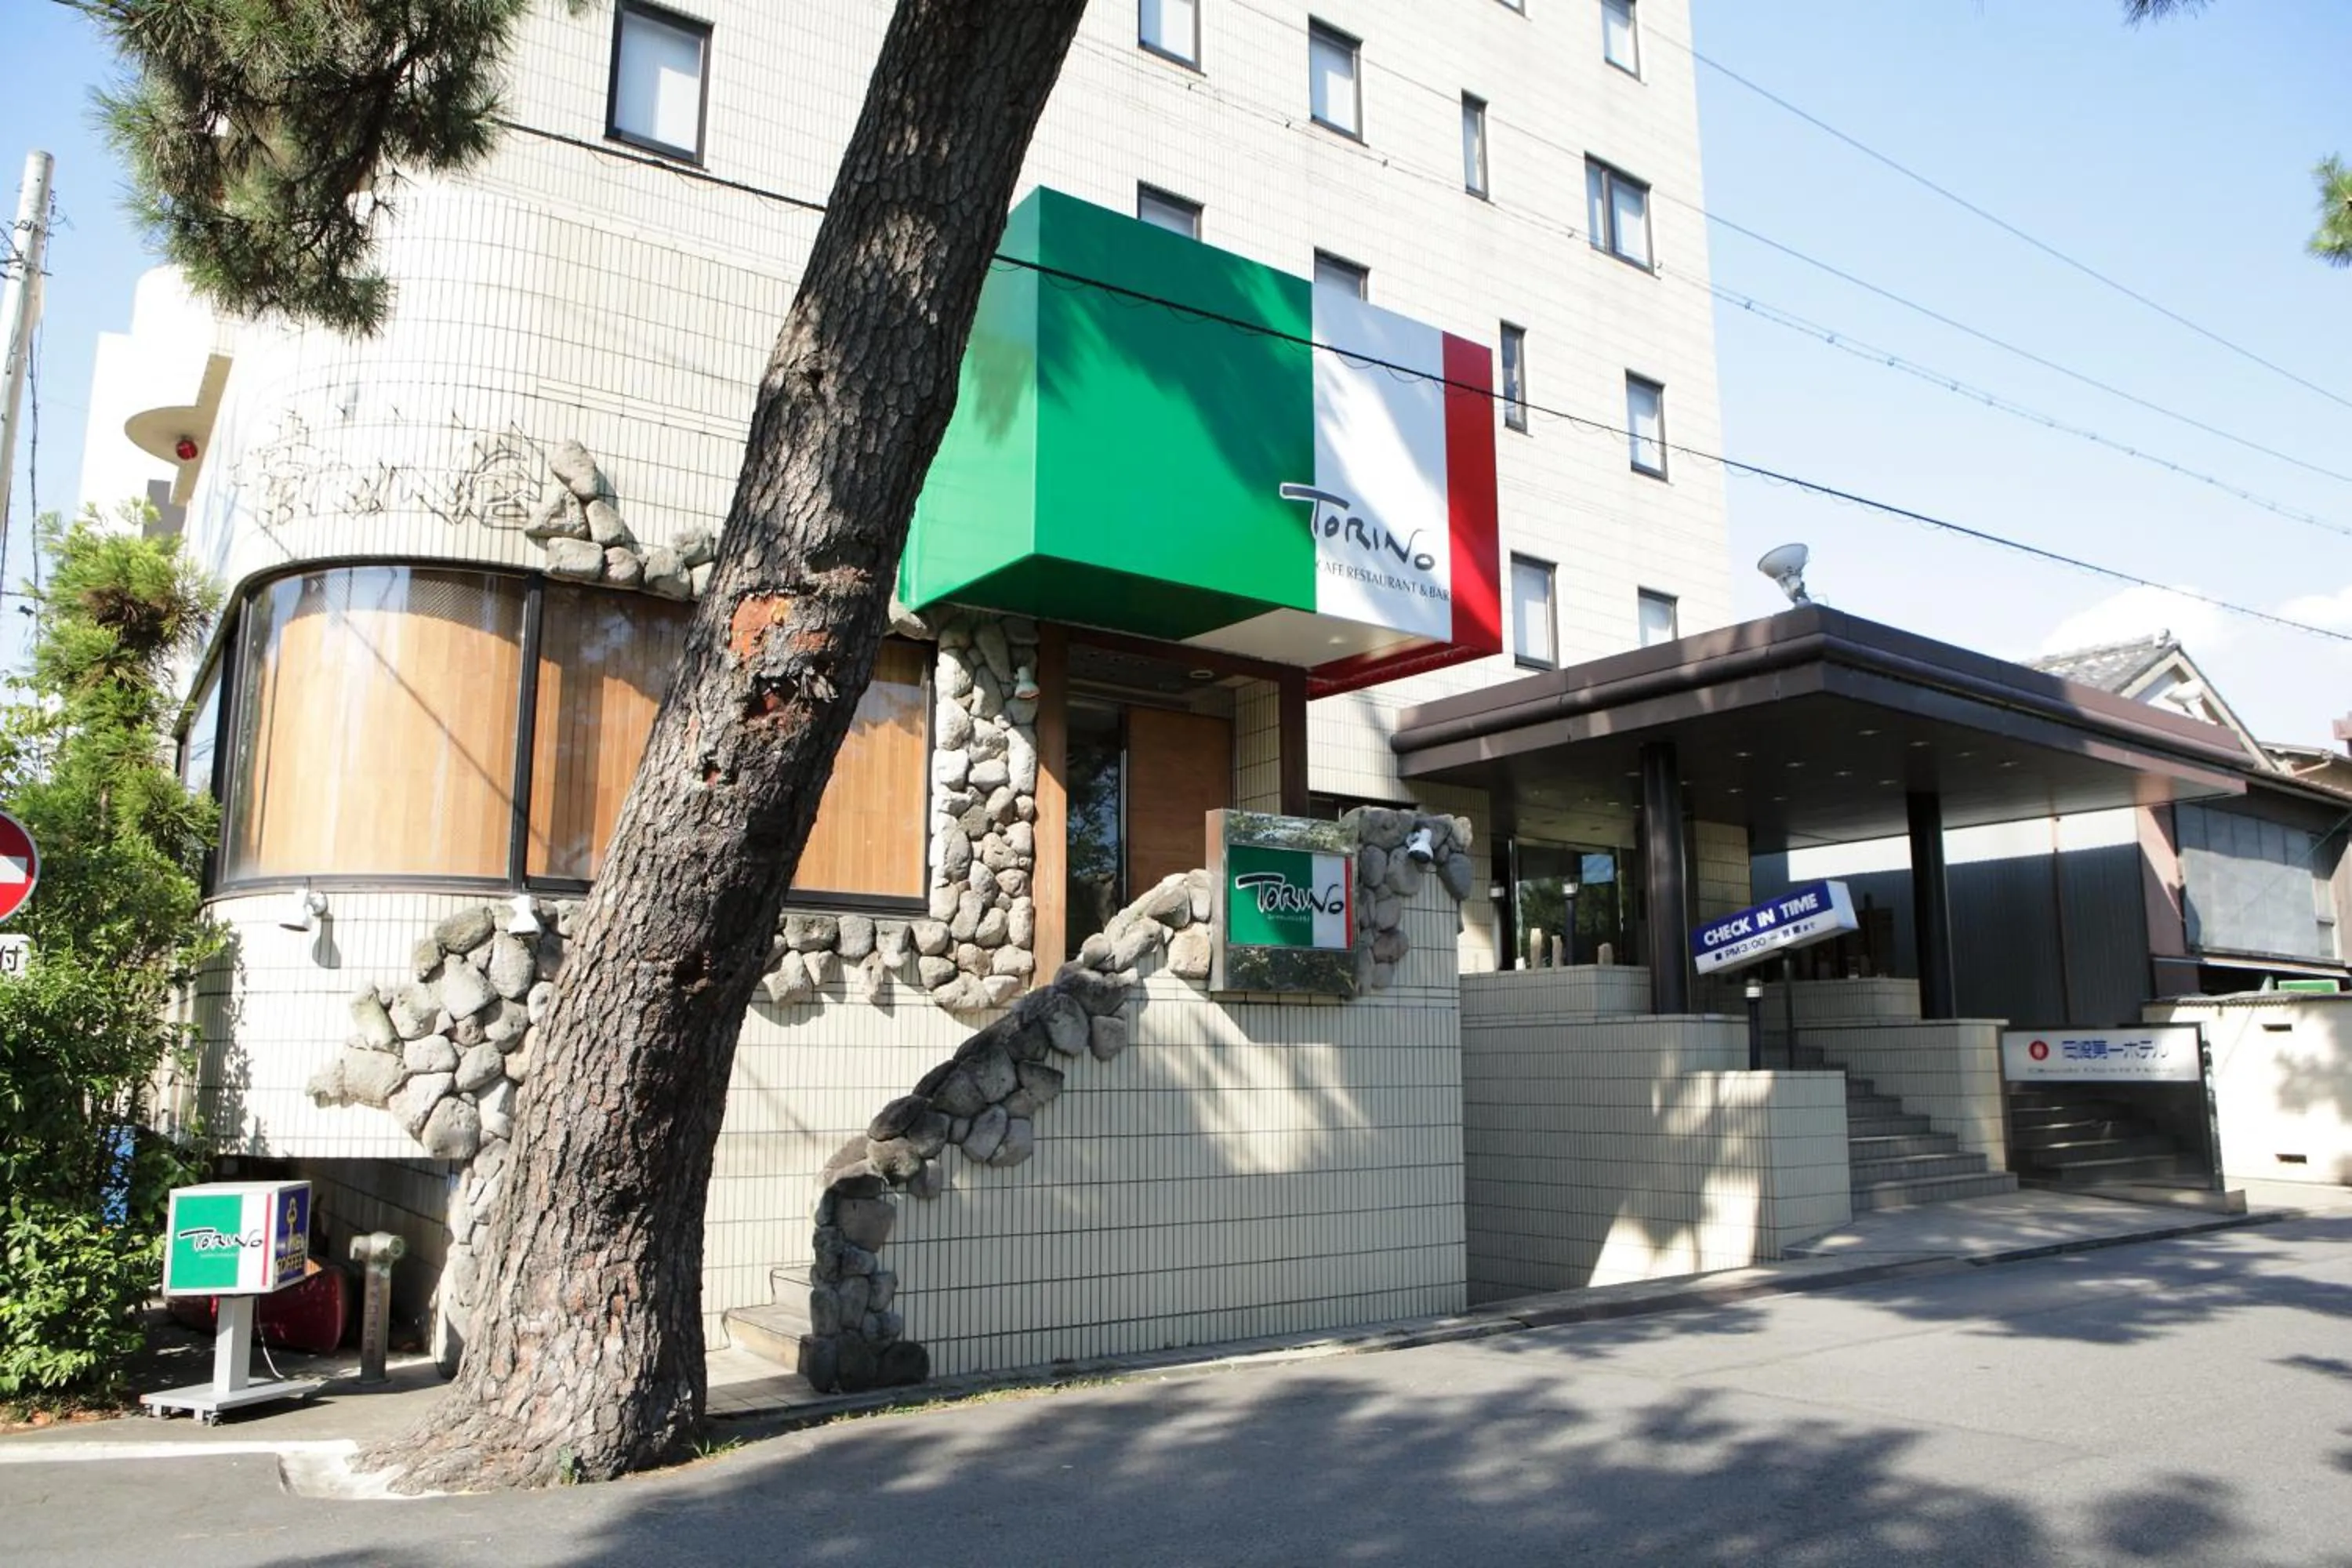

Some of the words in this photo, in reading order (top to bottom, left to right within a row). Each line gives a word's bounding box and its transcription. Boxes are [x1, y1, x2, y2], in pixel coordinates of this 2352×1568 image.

[1346, 565, 1416, 593] RESTAURANT
[1704, 916, 1751, 946] CHECK
[1756, 908, 1776, 928] IN
[1780, 893, 1819, 919] TIME
